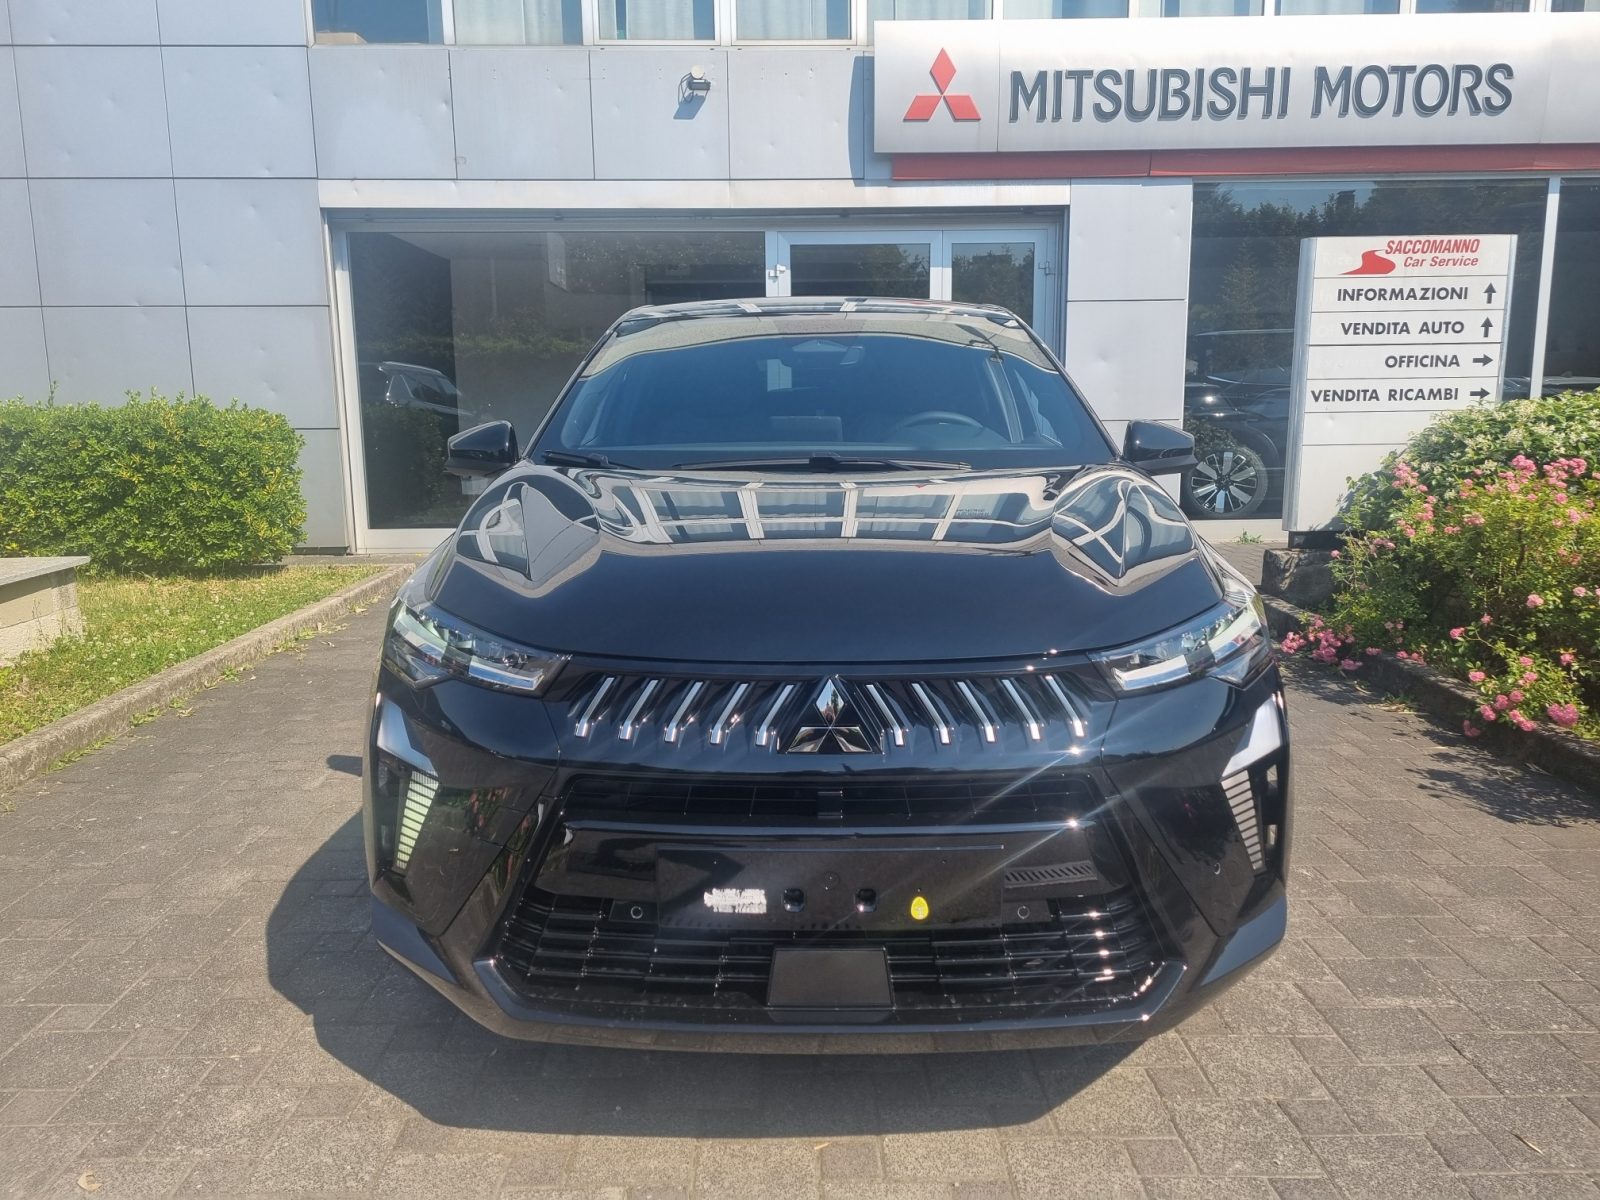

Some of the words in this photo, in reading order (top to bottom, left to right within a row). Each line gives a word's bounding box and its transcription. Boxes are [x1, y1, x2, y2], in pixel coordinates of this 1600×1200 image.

[1009, 67, 1291, 121] MITSUBISHI
[1311, 63, 1514, 116] MOTORS
[1385, 238, 1480, 254] SACCOMANNO
[1403, 256, 1427, 267] Car
[1429, 255, 1479, 267] Service
[1337, 286, 1469, 302] INFORMAZIONI
[1341, 321, 1411, 336] VENDITA
[1418, 320, 1465, 335] AUTO
[1384, 354, 1461, 369] OFFICINA
[1310, 388, 1380, 403] VENDITA
[1387, 387, 1459, 402] RICAMBI
